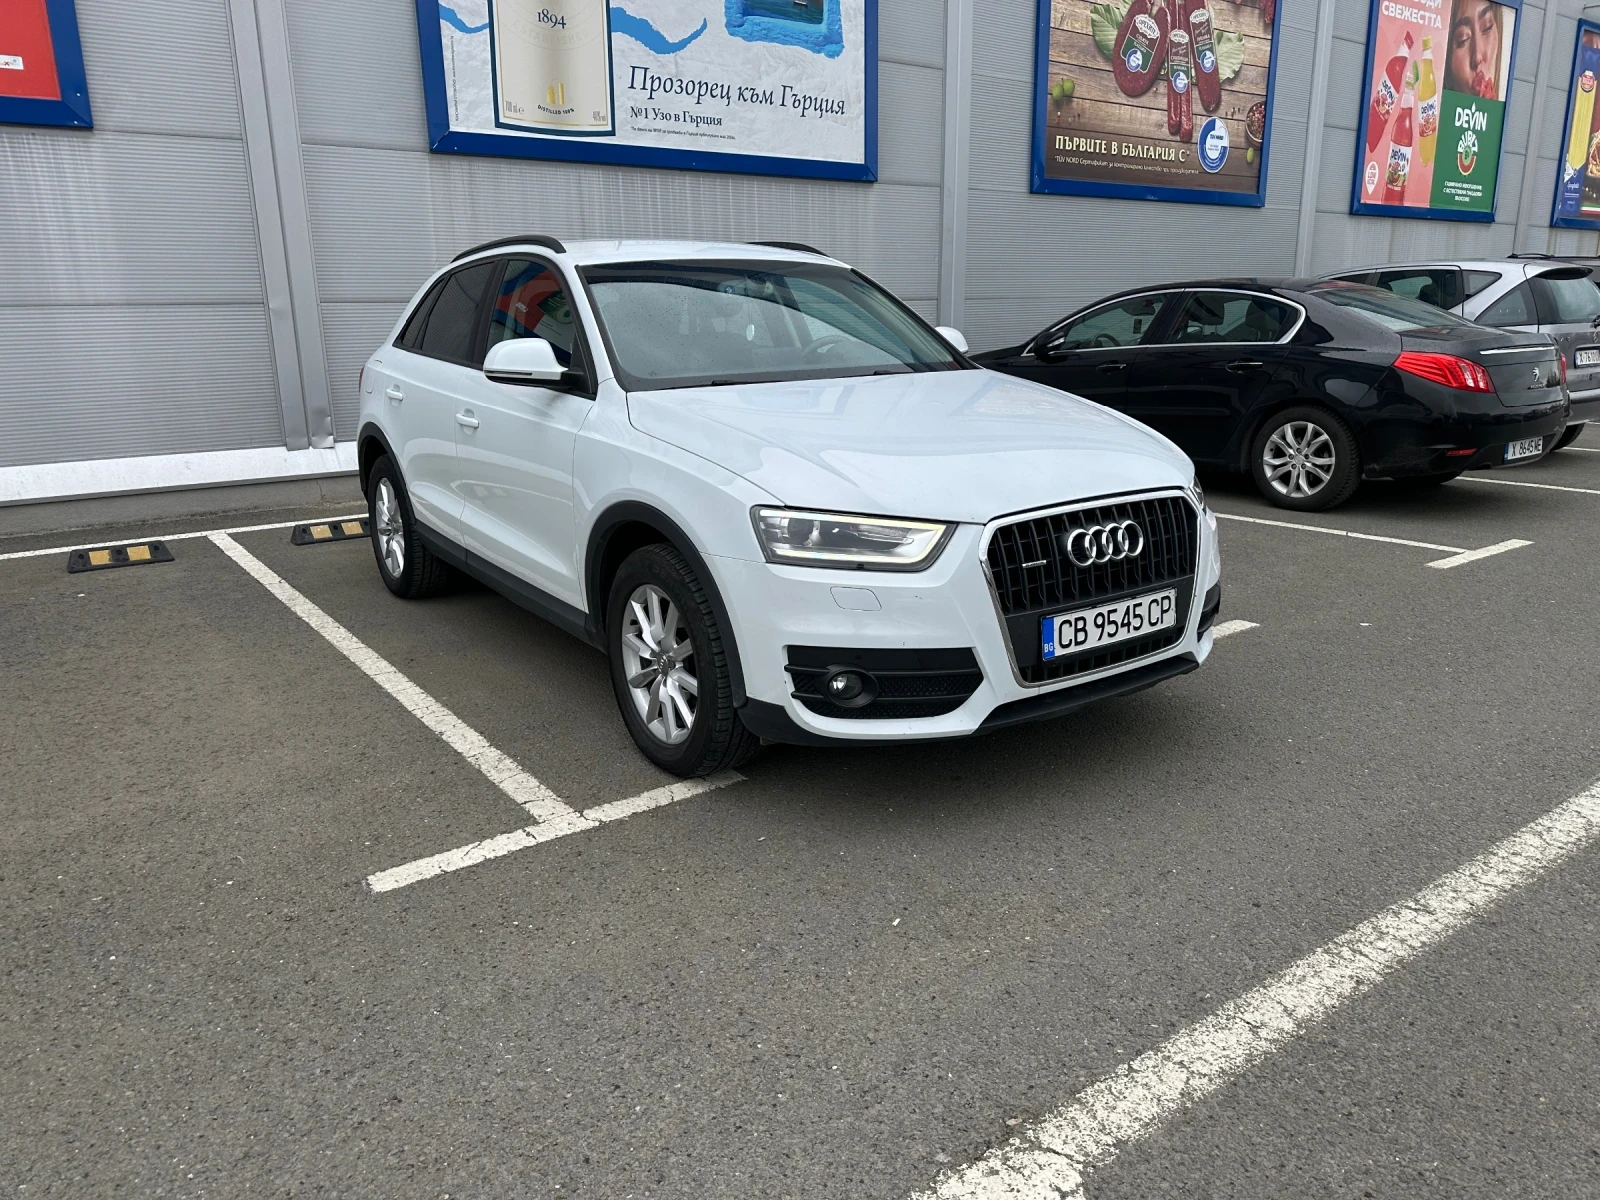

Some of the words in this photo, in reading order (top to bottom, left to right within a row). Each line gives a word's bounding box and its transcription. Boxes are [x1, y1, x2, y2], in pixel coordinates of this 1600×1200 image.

[536, 8, 567, 29] 1894
[1382, 1, 1442, 29] СВЕЖЕСТТА
[627, 65, 731, 107] Прозорец
[737, 85, 775, 106] към
[779, 84, 845, 118] Гърция
[537, 104, 562, 115] DISTILLED
[630, 105, 649, 119] №1
[651, 107, 672, 121] Узо
[674, 113, 681, 122] в
[682, 111, 723, 127] Гърция
[1455, 102, 1488, 132] DEVIN
[1055, 135, 1107, 154] ПЪРВИТЕ
[1111, 141, 1118, 155] В
[1121, 143, 1176, 161] БЪЛГАРИЯ
[1390, 148, 1407, 162] DEVIN
[1066, 156, 1079, 164] NORD
[1079, 157, 1108, 168] Сертификат
[1511, 445, 1516, 457] X
[1519, 440, 1534, 456] 8645
[1058, 616, 1088, 649] CB
[1093, 602, 1144, 642] 9545
[1148, 594, 1172, 627] CP
[1043, 642, 1054, 653] BG
